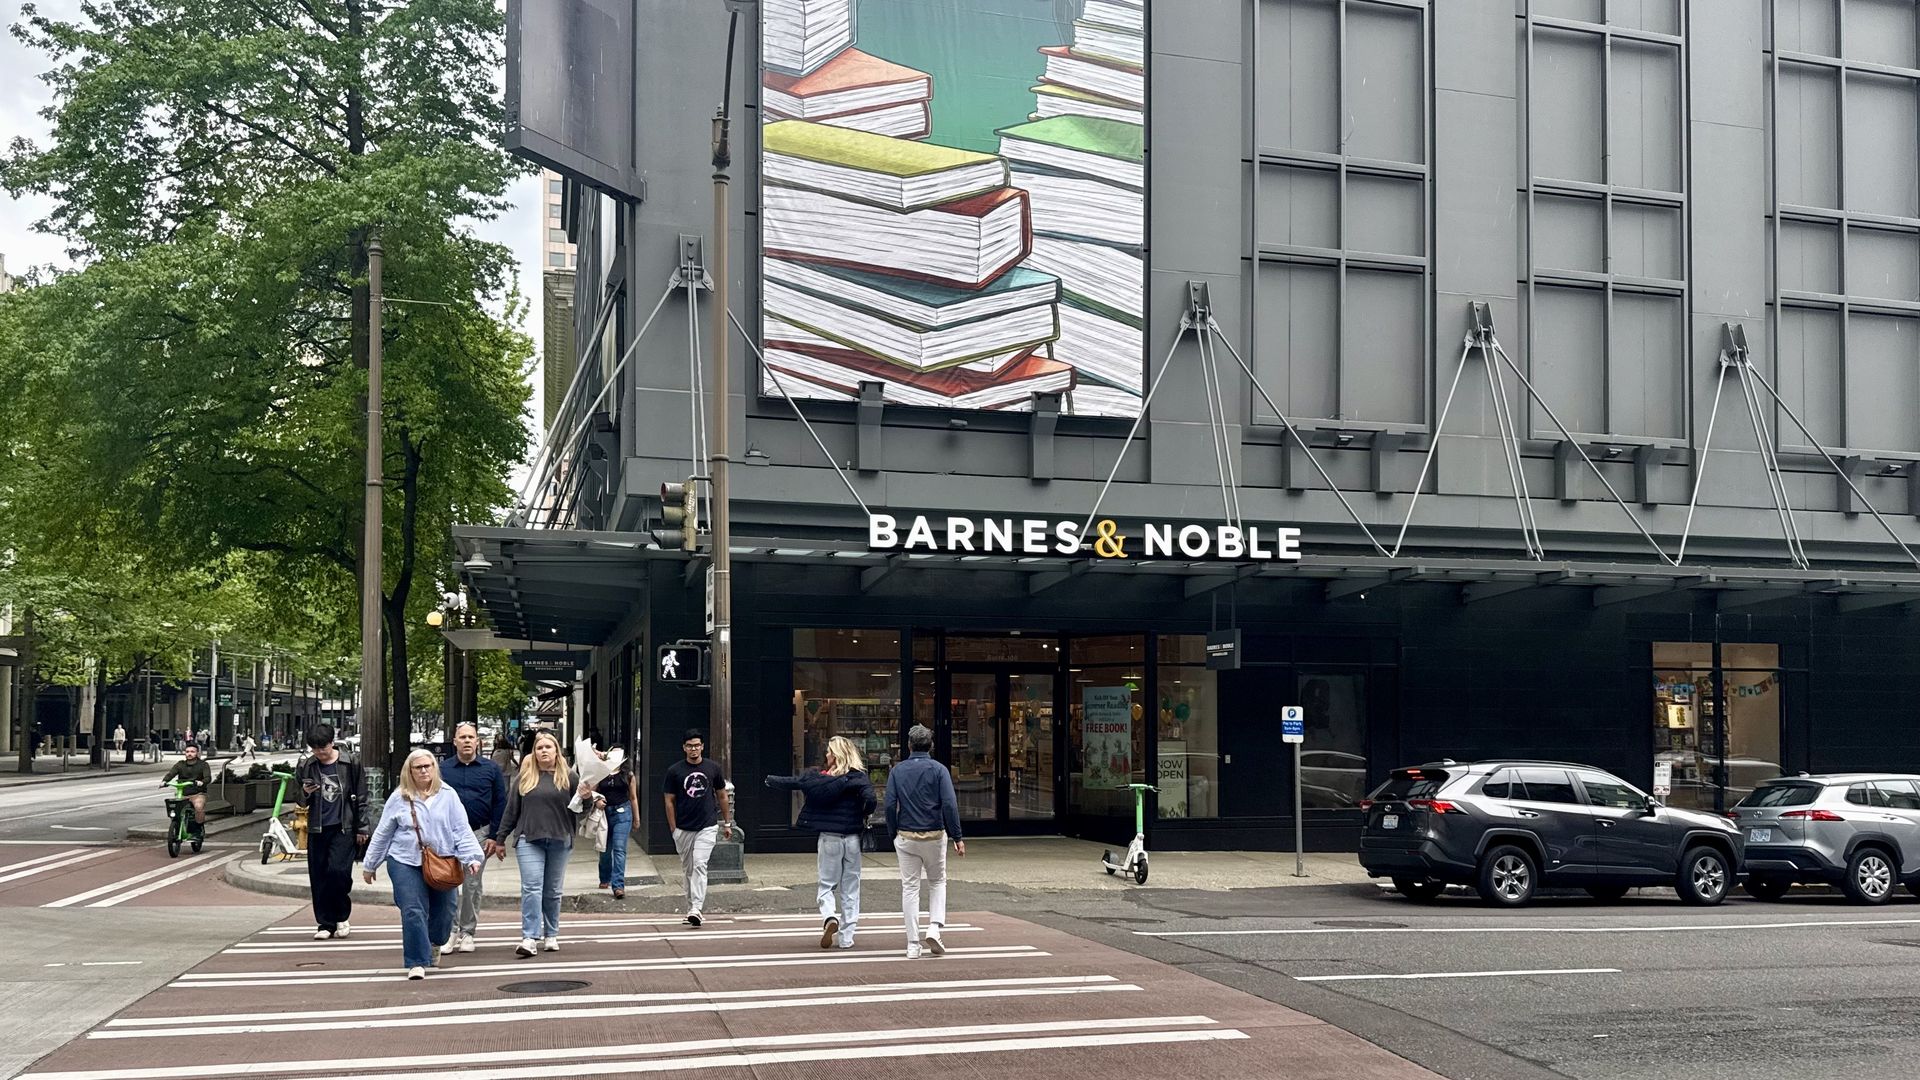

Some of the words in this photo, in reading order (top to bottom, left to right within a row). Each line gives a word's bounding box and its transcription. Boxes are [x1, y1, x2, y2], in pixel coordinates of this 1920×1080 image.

[869, 514, 1079, 554] BARNES
[1095, 519, 1129, 558] &
[1145, 524, 1302, 559] NOBLE
[1086, 722, 1103, 733] FREE
[1104, 722, 1128, 733] BOOK!
[1158, 760, 1183, 768] NOW
[1158, 770, 1184, 779] OPEN
